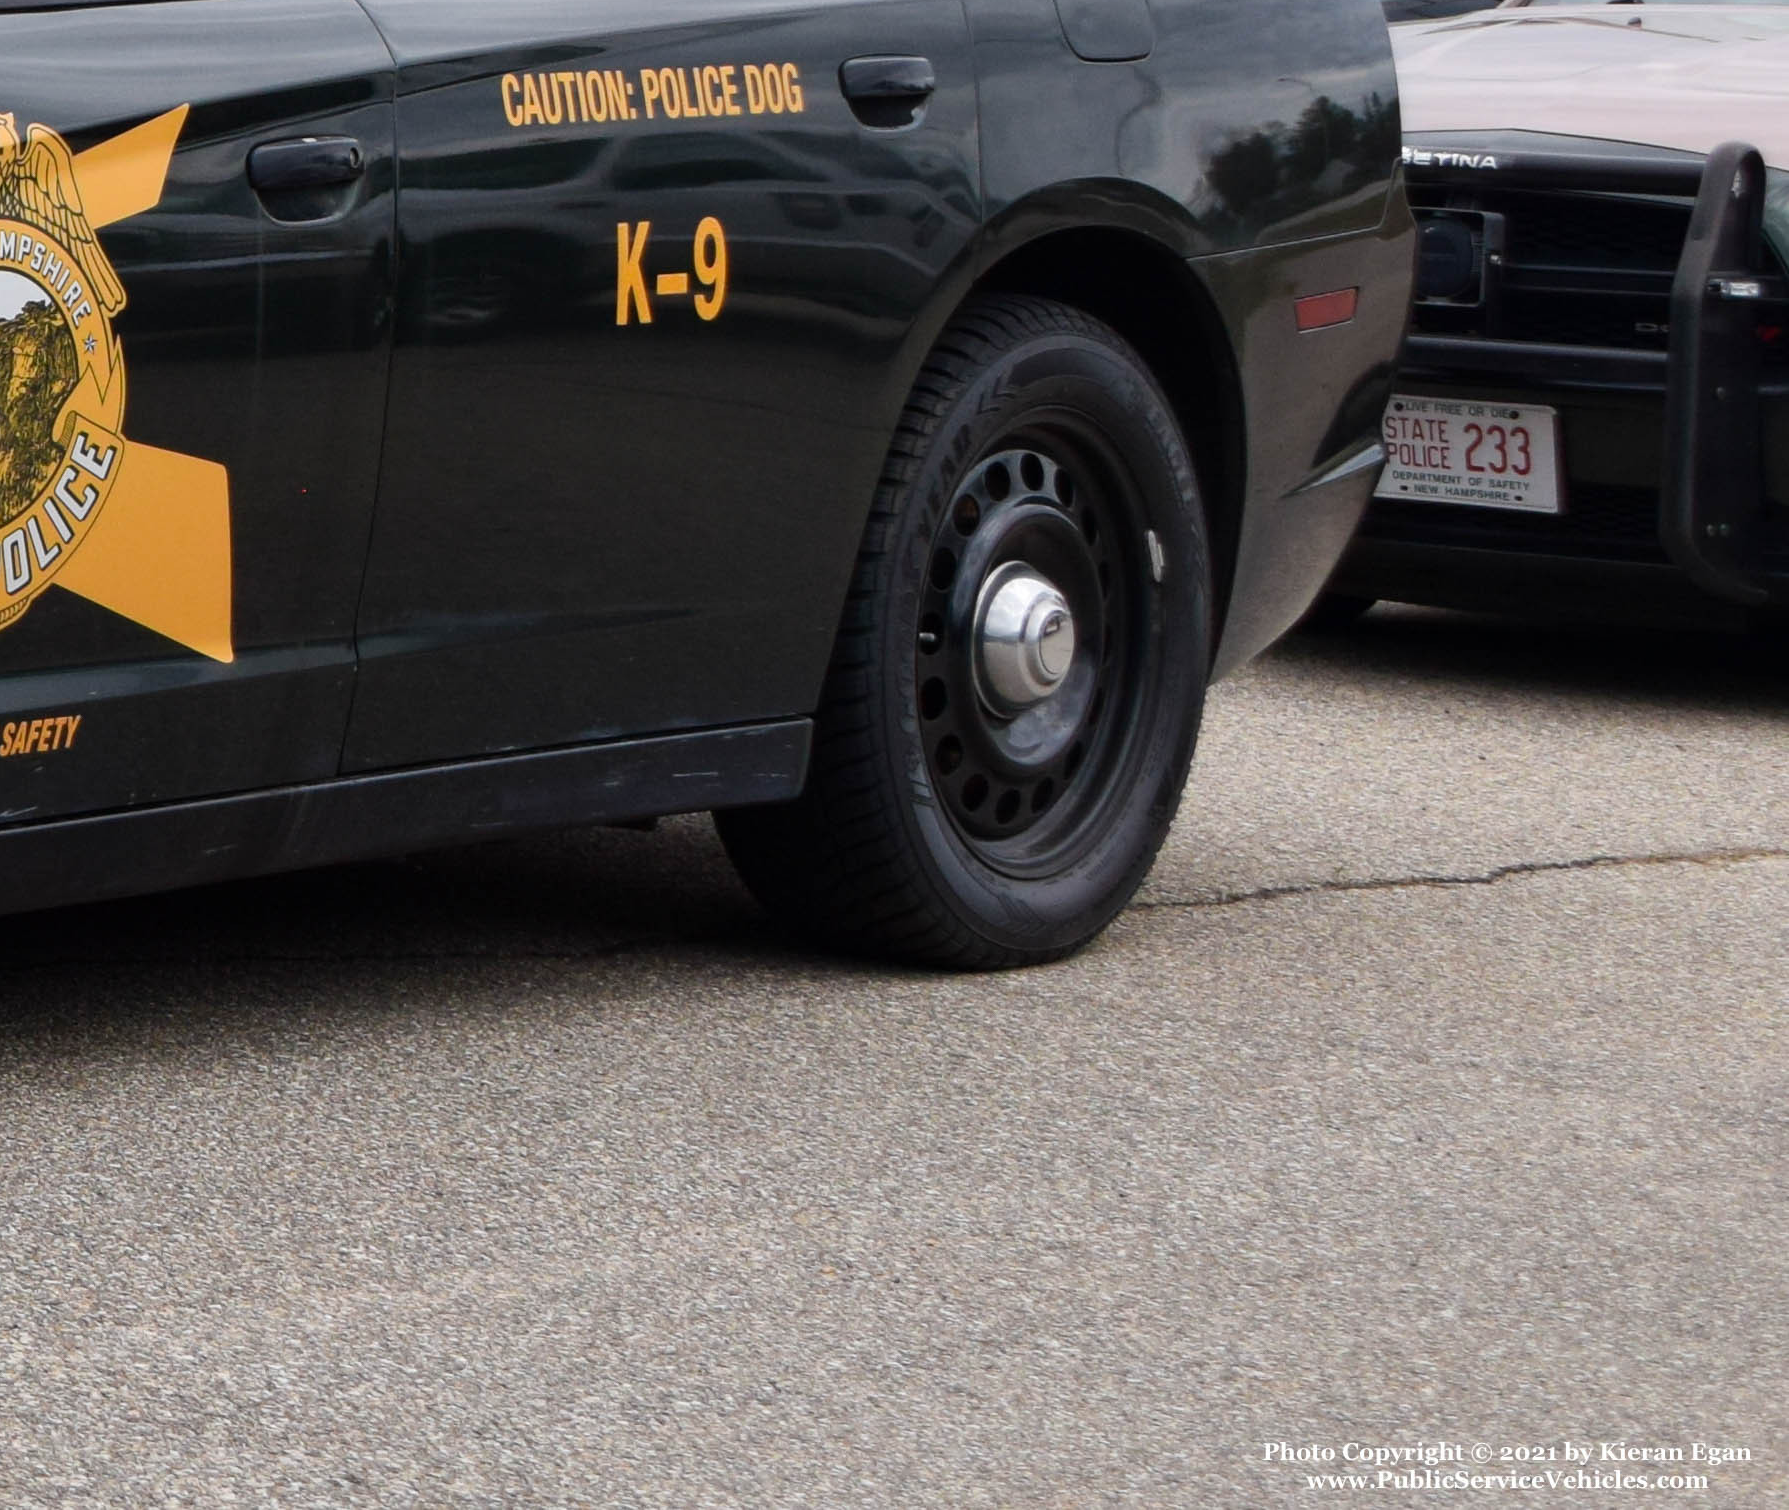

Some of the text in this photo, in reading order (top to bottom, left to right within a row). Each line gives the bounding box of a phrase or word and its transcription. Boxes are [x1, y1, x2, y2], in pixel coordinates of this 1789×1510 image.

[501, 62, 804, 127] CAUTION: POLICE DOG
[616, 216, 727, 326] K-9
[1405, 402, 1427, 413] LIVE
[1435, 404, 1463, 415] FREE
[1469, 407, 1485, 417] OR
[1385, 416, 1532, 476] STATE 233
[1386, 442, 1452, 470] POLICE
[1392, 470, 1530, 491] DEPARTMENT OF SAFETY
[1414, 484, 1510, 502] NEW HAMPSHIRE
